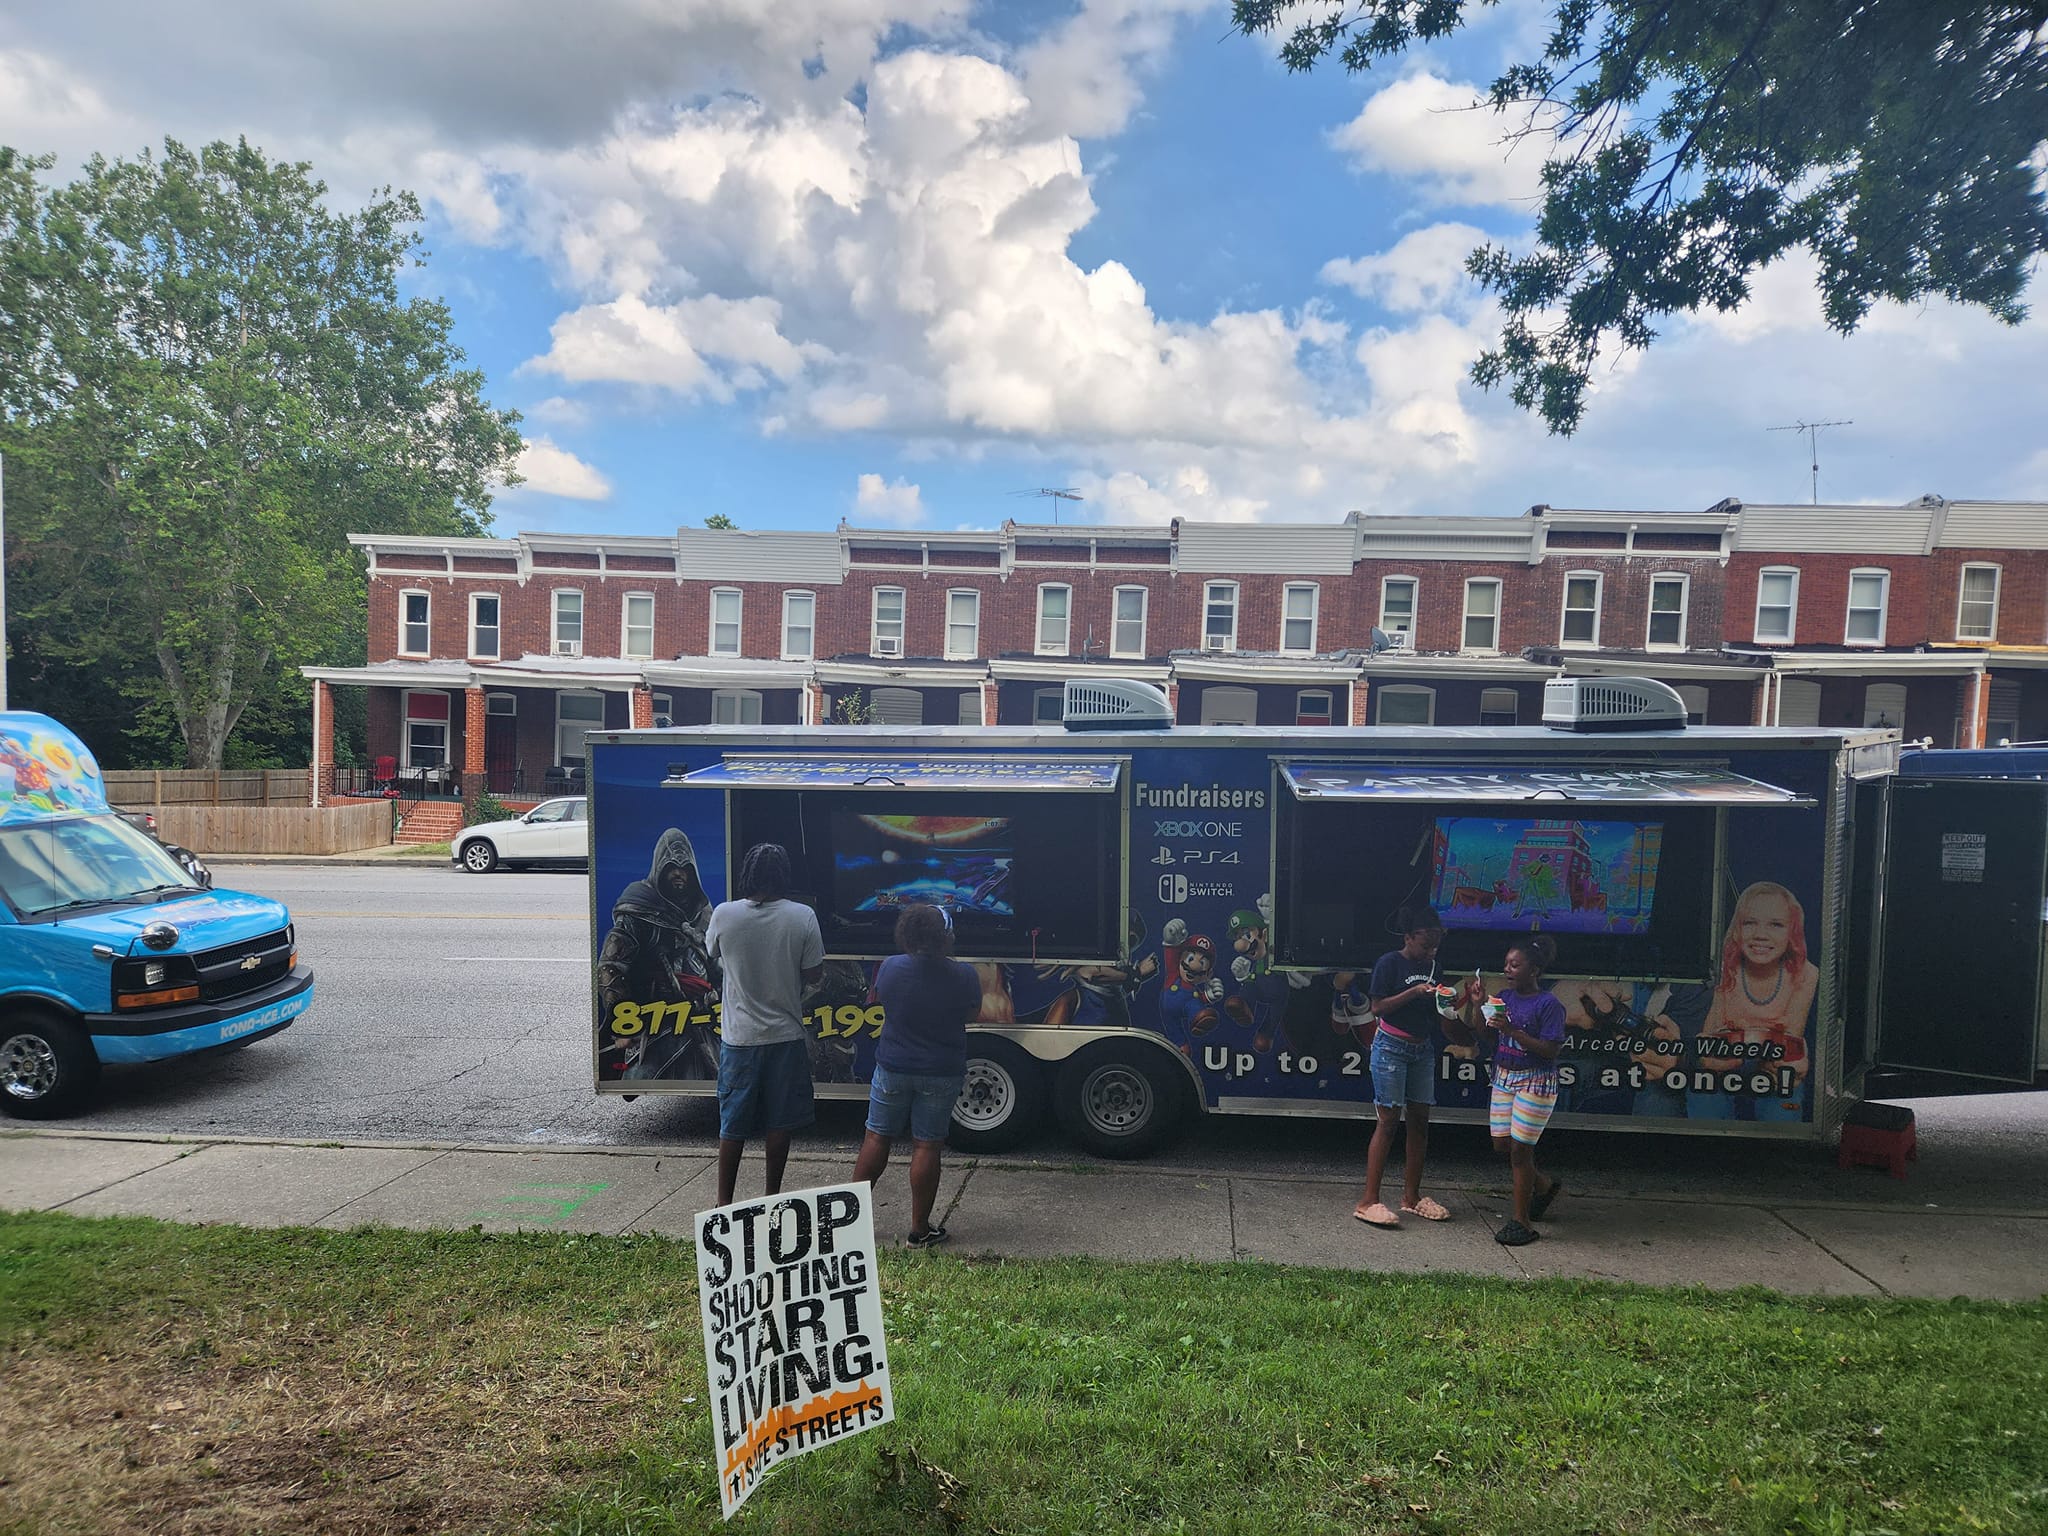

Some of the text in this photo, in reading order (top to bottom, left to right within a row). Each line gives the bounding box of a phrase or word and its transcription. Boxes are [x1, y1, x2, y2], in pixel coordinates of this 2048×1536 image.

[1309, 770, 1711, 787] PARTY GAME
[1435, 783, 1645, 795] TRUCK
[1136, 783, 1265, 808] Fundraisers
[1154, 821, 1242, 837] XBOX ONE
[1183, 850, 1241, 864] PS4
[1189, 888, 1233, 896] SWITCH
[220, 999, 303, 1039] KONA-ICE.COM
[1561, 1036, 1784, 1059] Arcade on Wheels
[1204, 1046, 1255, 1076] Up
[1278, 1051, 1318, 1073] to
[1342, 1052, 1368, 1075] 2
[1600, 1065, 1642, 1087] at
[1666, 1069, 1791, 1095] once!
[702, 1191, 860, 1289] STOP
[709, 1250, 867, 1334] SHOOTING
[714, 1286, 867, 1390] START
[719, 1334, 884, 1450] LIVING.
[745, 1396, 884, 1486] SAFE STREETS
